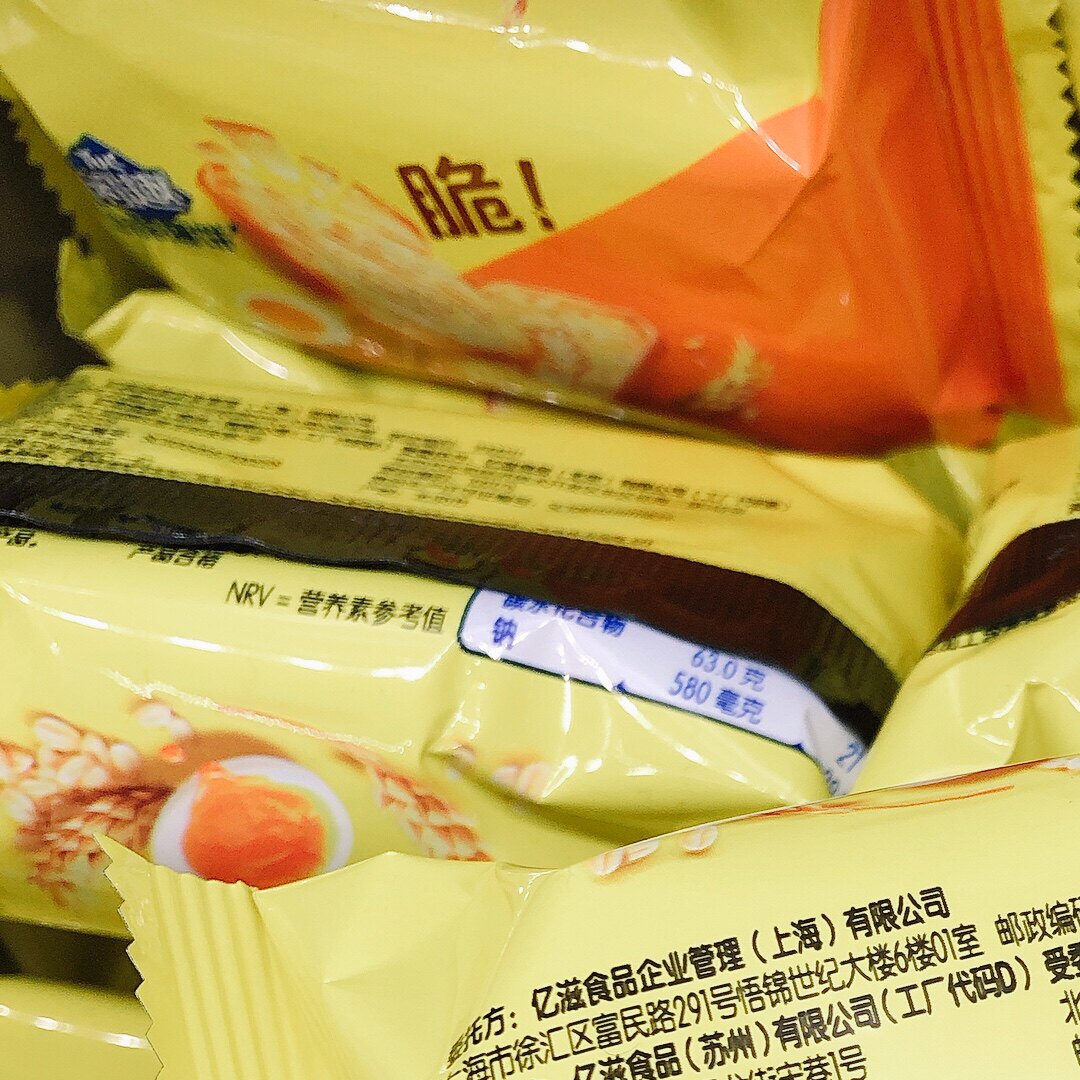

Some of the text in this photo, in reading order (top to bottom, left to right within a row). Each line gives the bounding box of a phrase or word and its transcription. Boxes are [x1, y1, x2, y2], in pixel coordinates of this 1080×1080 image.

[226, 580, 275, 609] NRV
[297, 588, 449, 635] 营养素参考值
[668, 671, 766, 726] 580 毫克
[742, 661, 766, 692] 克
